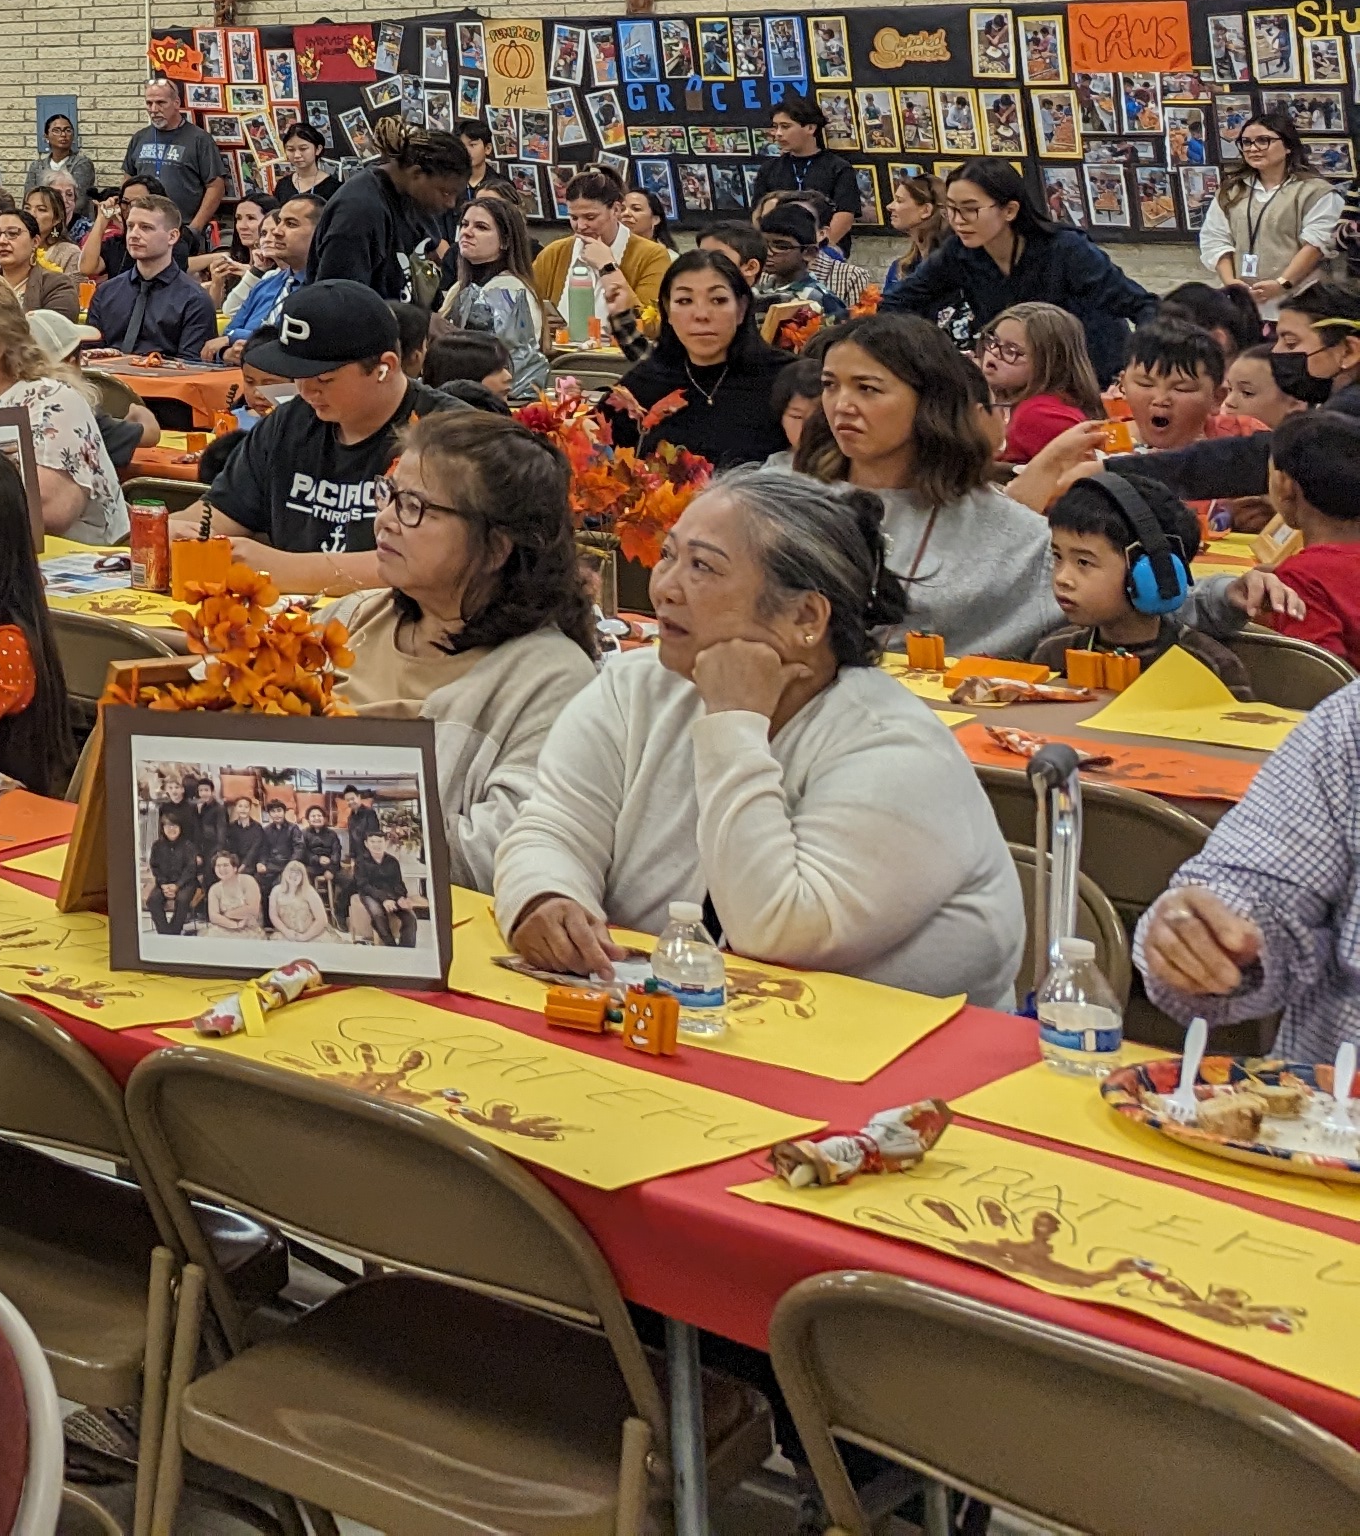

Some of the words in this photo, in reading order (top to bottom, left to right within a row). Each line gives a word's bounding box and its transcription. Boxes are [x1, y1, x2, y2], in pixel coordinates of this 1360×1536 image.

[489, 25, 540, 43] PUMPKIN
[1078, 13, 1178, 64] YAMS
[156, 46, 186, 63] POP
[626, 74, 808, 112] GROCERY
[280, 313, 311, 346] P
[312, 504, 362, 524] THROS
